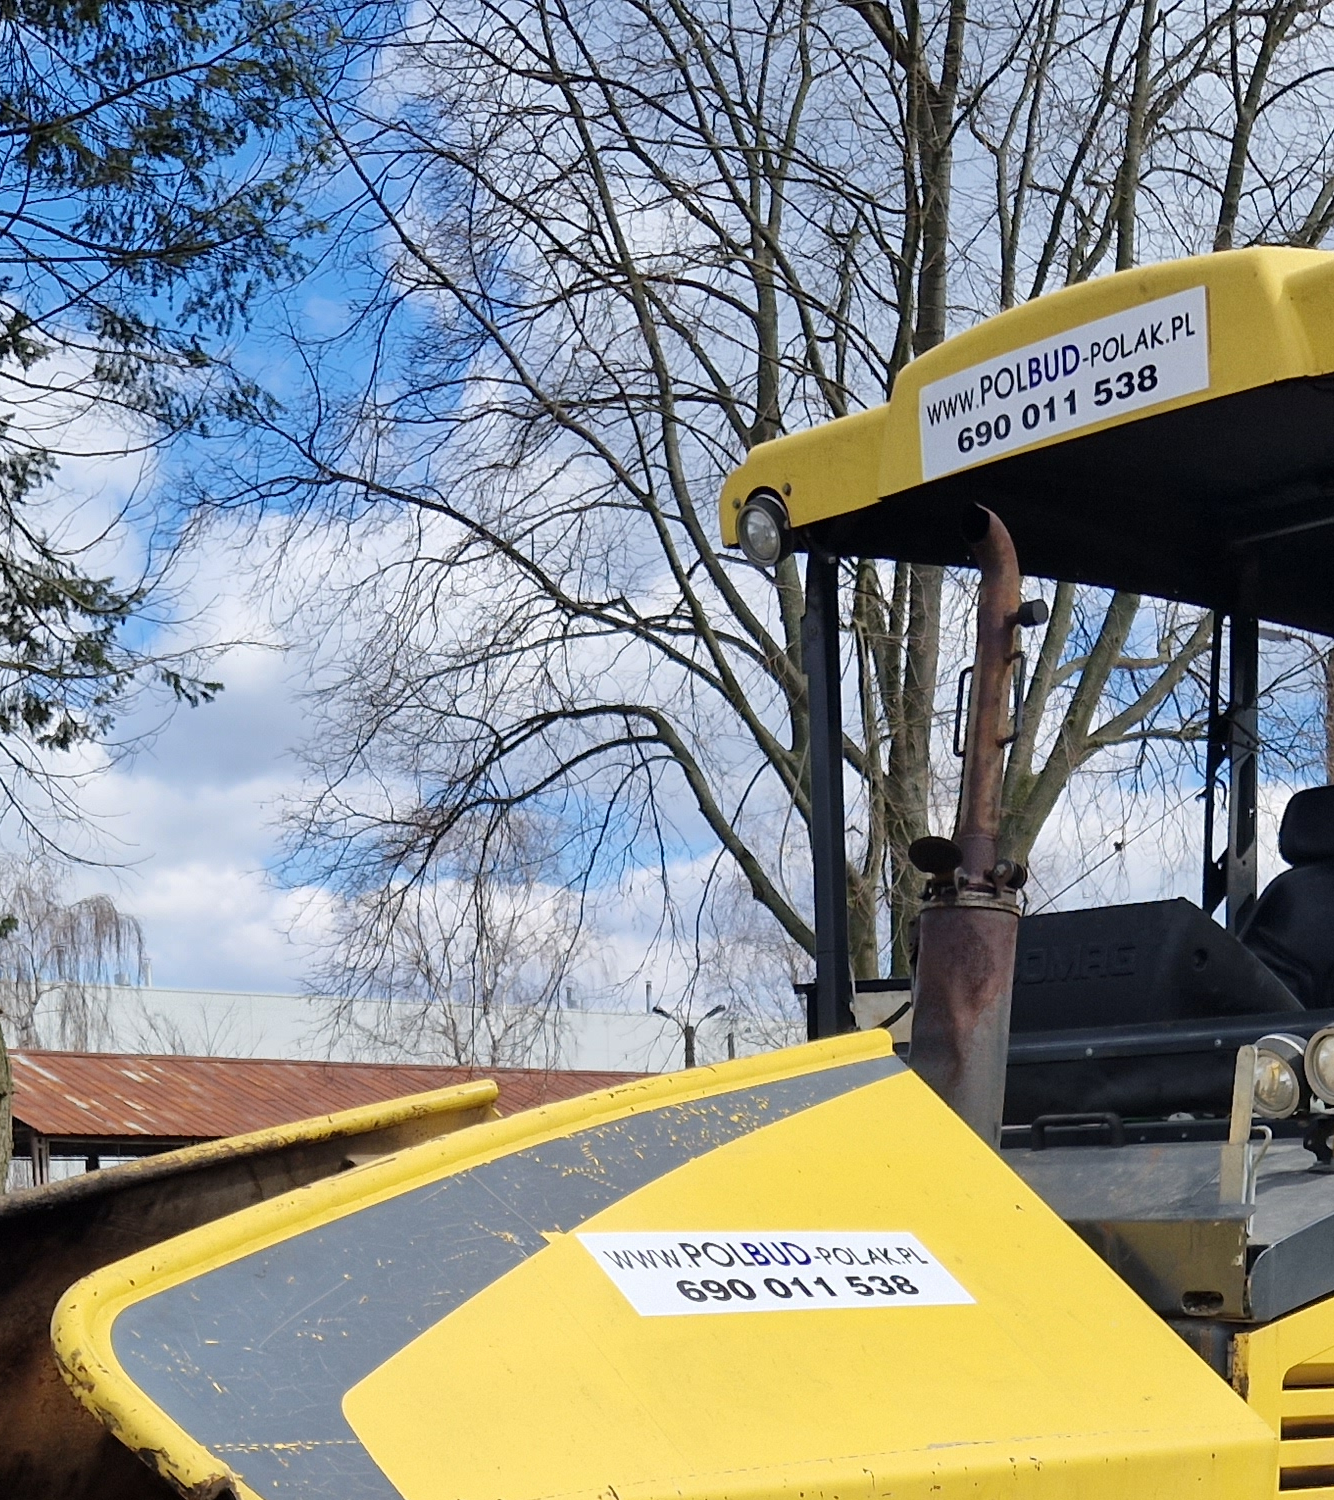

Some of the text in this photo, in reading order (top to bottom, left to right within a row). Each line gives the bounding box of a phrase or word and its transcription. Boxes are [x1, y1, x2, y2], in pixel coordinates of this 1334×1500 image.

[957, 363, 1159, 453] 690 011 538
[1013, 942, 1137, 986] OMAG
[676, 1274, 920, 1303] 690 011 538
